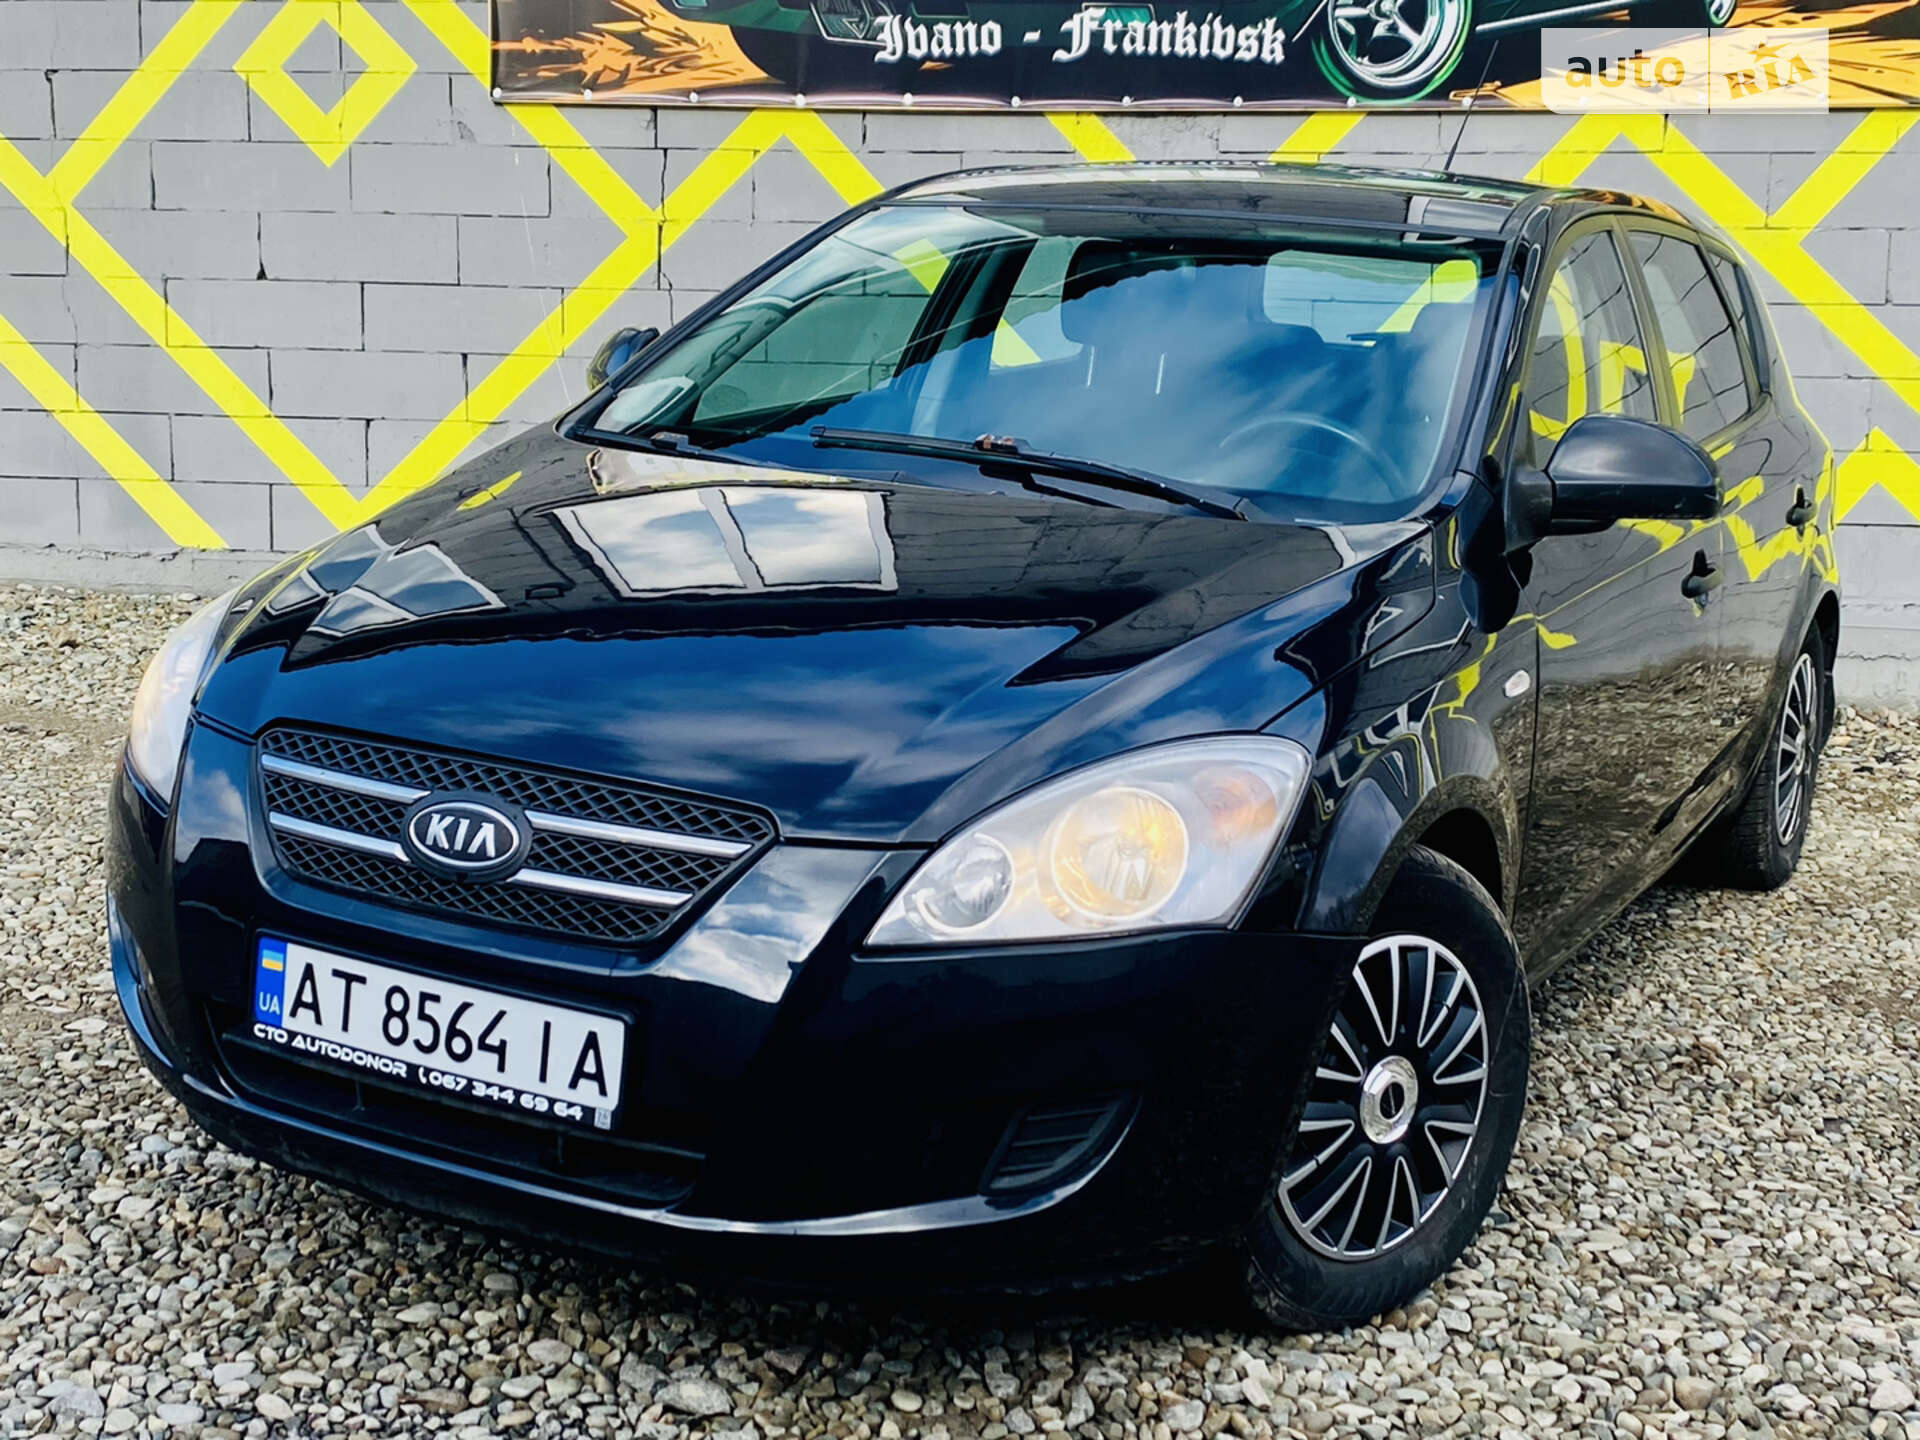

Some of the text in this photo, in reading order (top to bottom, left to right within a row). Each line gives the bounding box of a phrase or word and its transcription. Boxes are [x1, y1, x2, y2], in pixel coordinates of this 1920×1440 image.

[874, 14, 1002, 64] Ivano
[1052, 7, 1287, 64] Frankivsk
[425, 813, 496, 858] KIA
[258, 991, 281, 1016] UA
[289, 962, 608, 1097] AT 8564 IA
[291, 1034, 407, 1078] AUTODONOR
[428, 1071, 468, 1091] 067
[472, 1080, 515, 1104] 344
[519, 1093, 550, 1112] 69
[553, 1101, 583, 1121] 64
